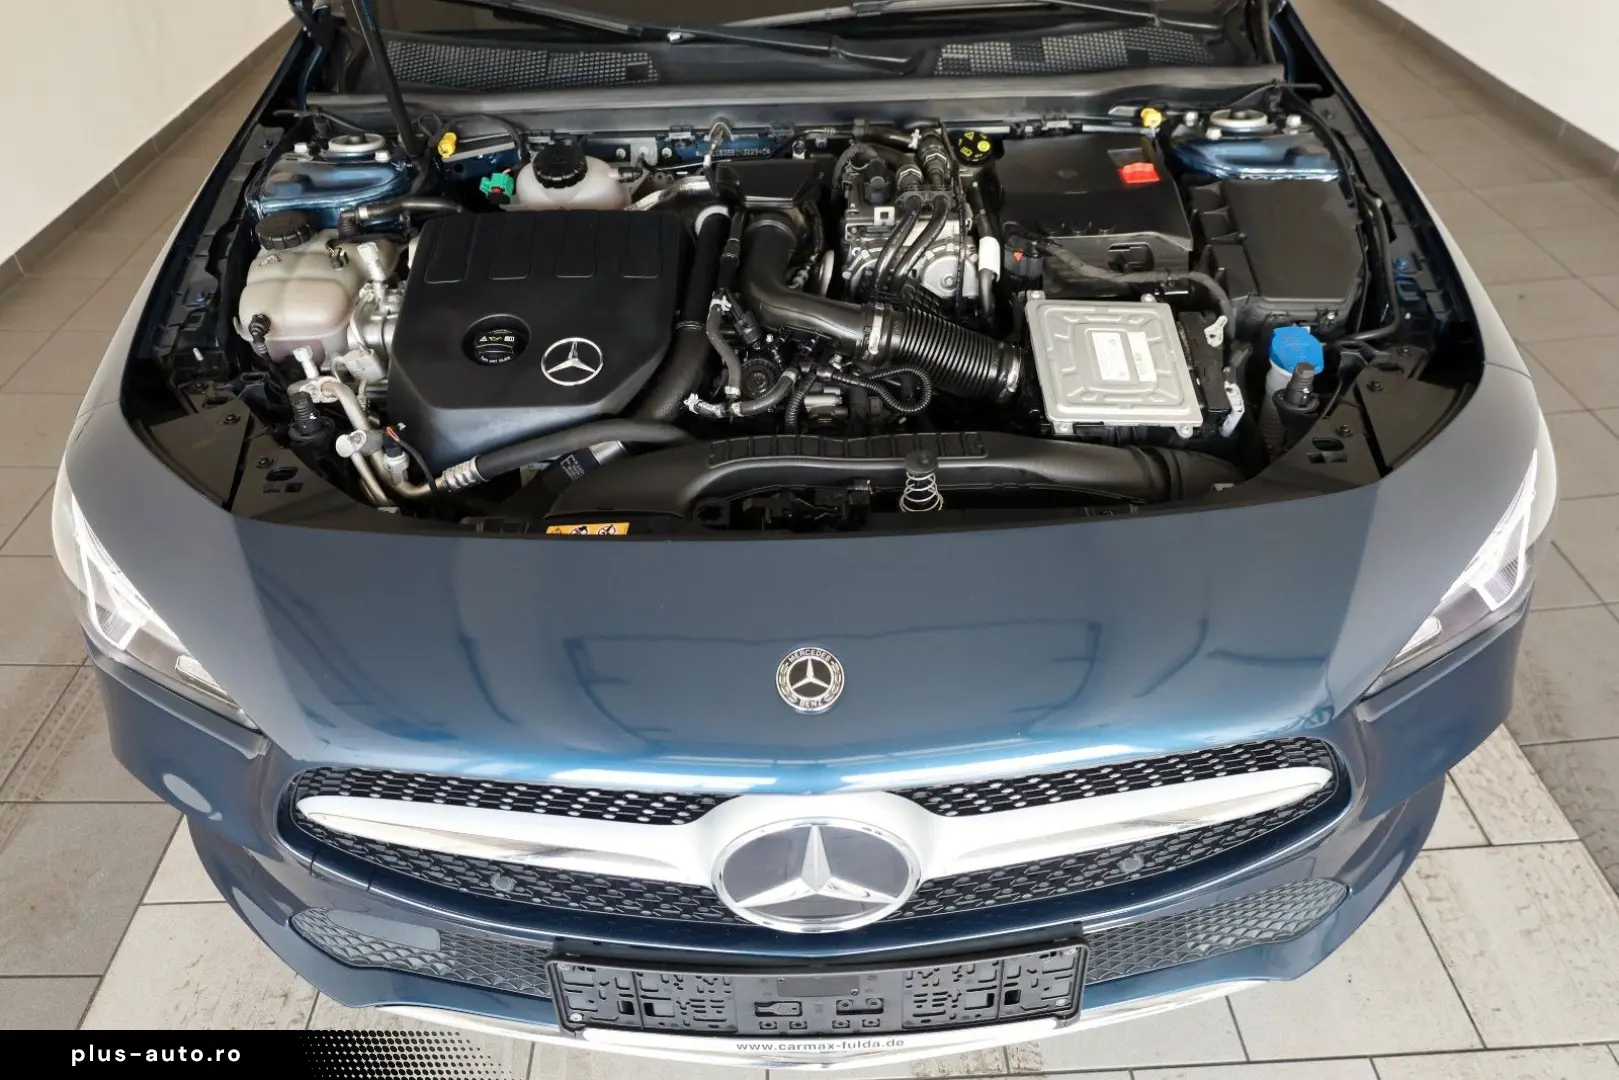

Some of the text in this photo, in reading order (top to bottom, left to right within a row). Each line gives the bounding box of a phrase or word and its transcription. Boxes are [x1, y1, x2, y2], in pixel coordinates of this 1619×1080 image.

[788, 649, 832, 663] MERCEDES
[799, 699, 825, 708] BENZ
[736, 1038, 905, 1051] www.carmax-fulda.de
